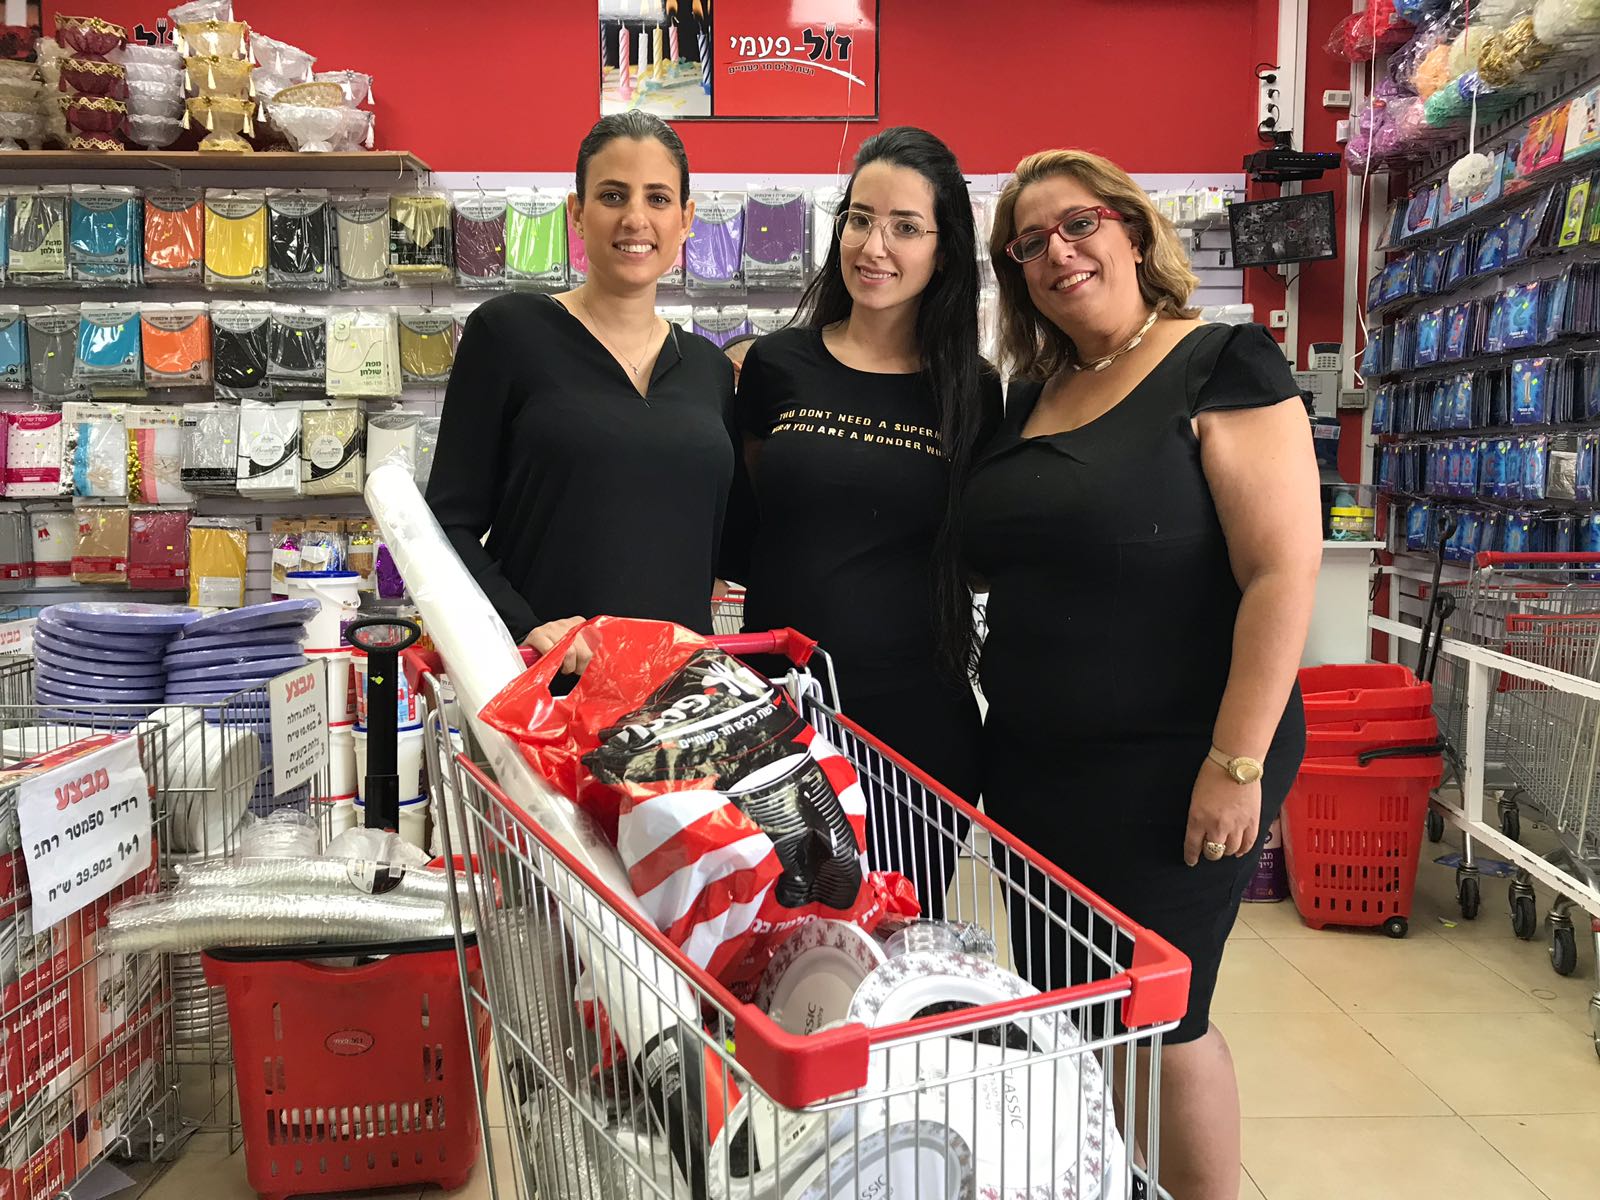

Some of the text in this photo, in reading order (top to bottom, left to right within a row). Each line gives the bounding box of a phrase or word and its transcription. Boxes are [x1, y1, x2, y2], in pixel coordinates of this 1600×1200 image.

[728, 64, 759, 74] פעמיים
[774, 62, 794, 71] כלים
[795, 65, 815, 76] רשת
[360, 368, 381, 376] שולחן
[799, 408, 832, 420] DONT
[838, 413, 872, 426] NEED
[878, 420, 887, 429] A
[792, 423, 814, 432] YOU
[817, 425, 845, 438] ARE
[850, 431, 858, 440] A
[863, 433, 921, 450] WONDER
[285, 673, 315, 703] מבצע
[679, 702, 778, 749] רשת כלים חד פעמיים
[54, 767, 110, 811] מבצע
[110, 796, 138, 819] רדיד
[33, 834, 60, 860] רחב
[117, 834, 140, 861] 1+1
[48, 879, 72, 902] ש"ח
[804, 1001, 816, 1036] SSIC
[1003, 1067, 1024, 1130] LASSIC
[861, 1174, 887, 1200] SSIC
